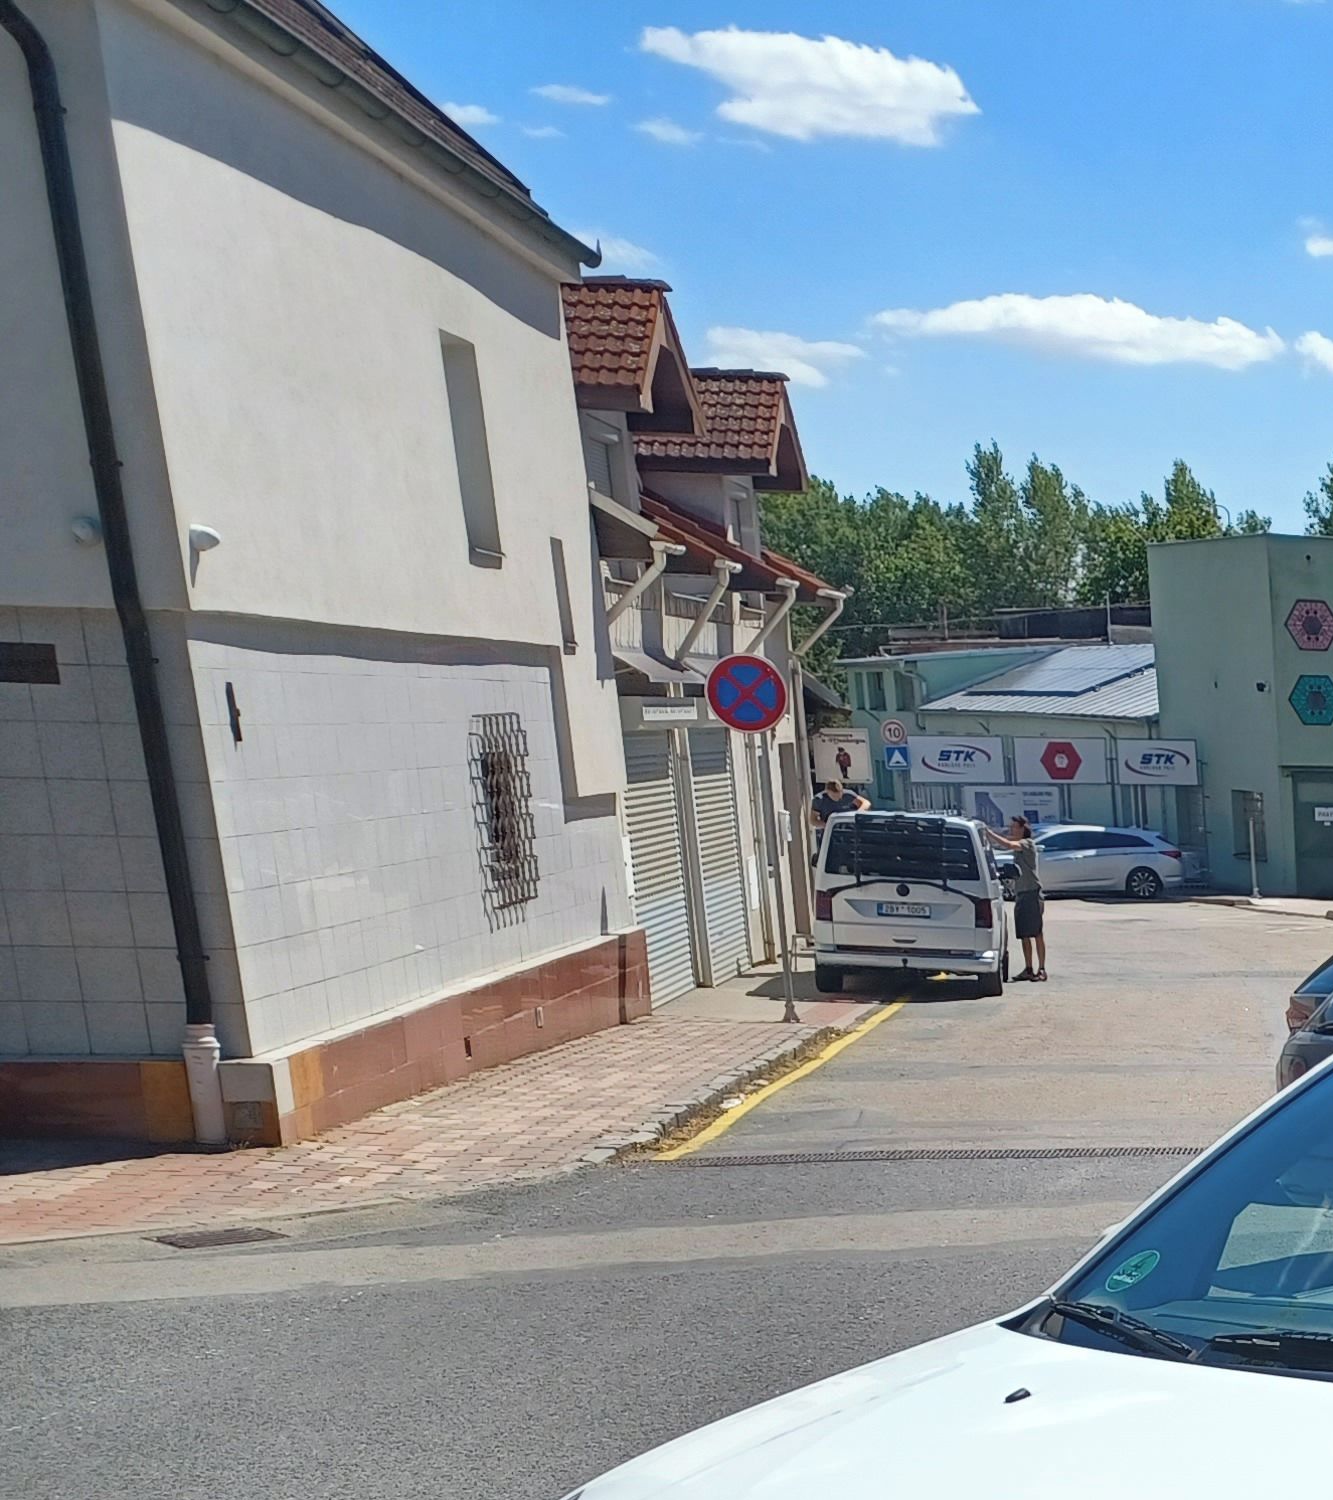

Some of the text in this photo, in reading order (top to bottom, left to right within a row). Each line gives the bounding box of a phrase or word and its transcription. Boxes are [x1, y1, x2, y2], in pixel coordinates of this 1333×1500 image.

[887, 727, 901, 738] 10
[938, 750, 976, 762] STK
[1140, 753, 1176, 765] STK
